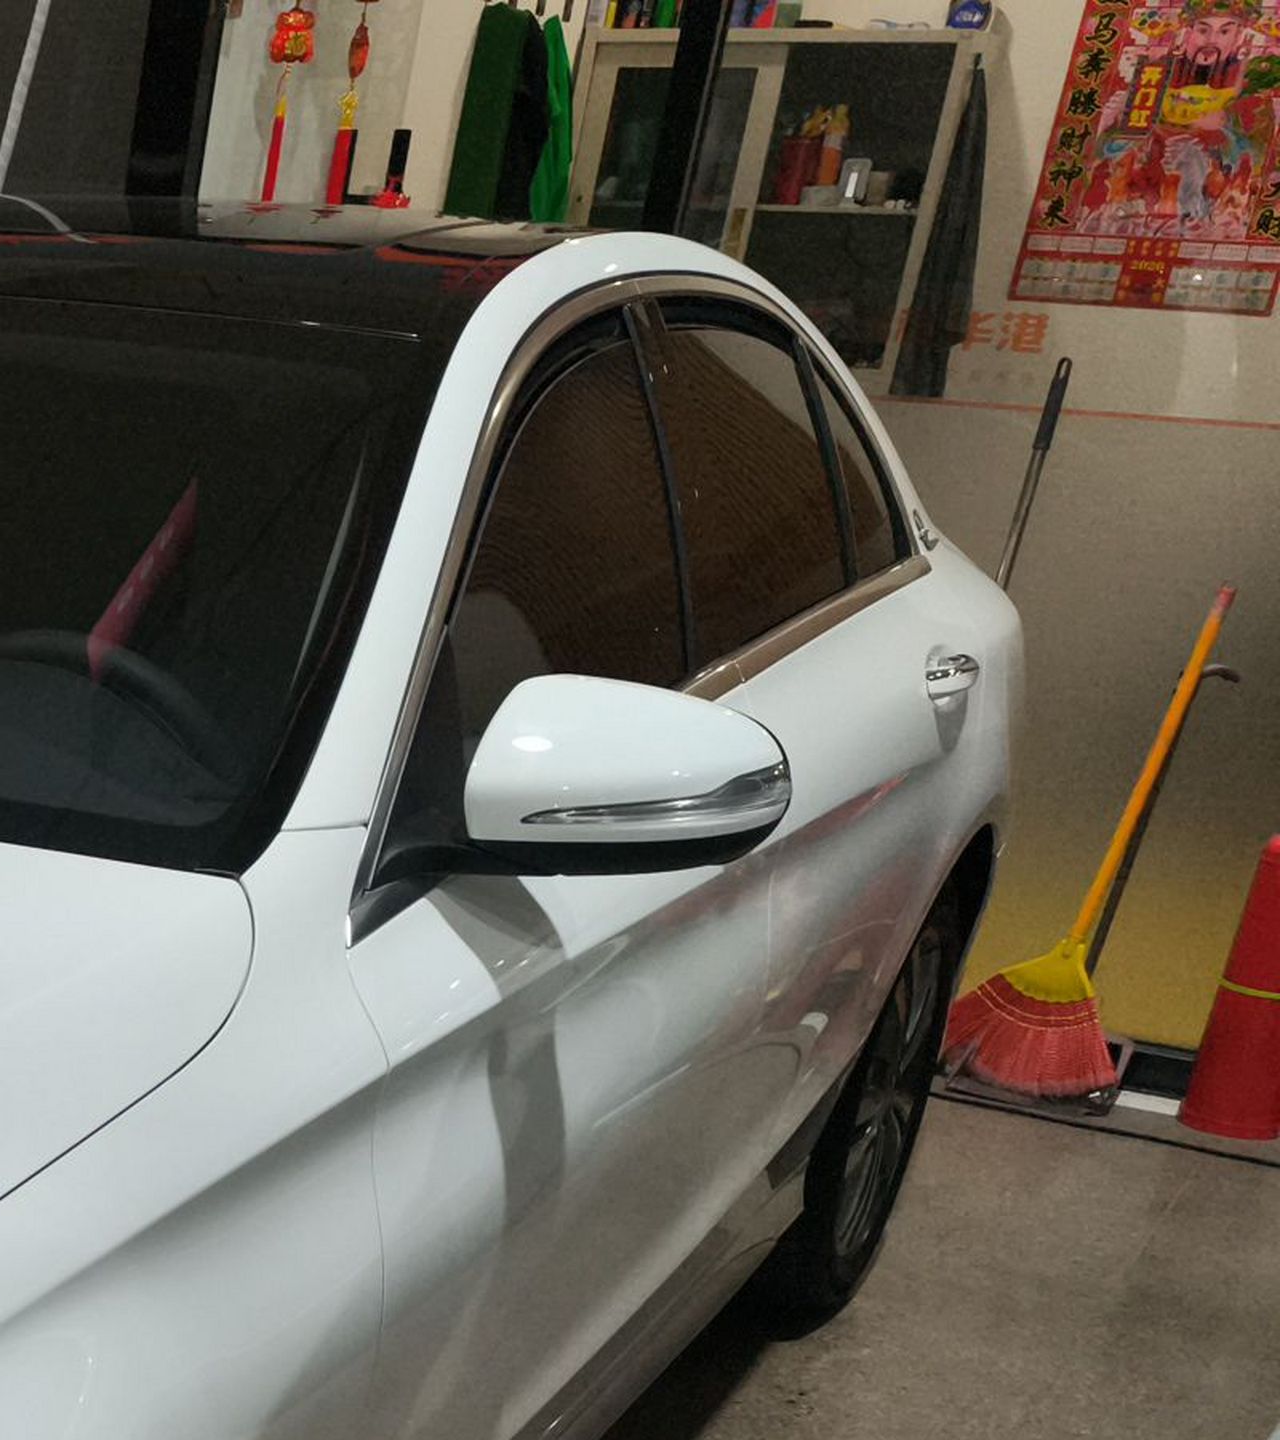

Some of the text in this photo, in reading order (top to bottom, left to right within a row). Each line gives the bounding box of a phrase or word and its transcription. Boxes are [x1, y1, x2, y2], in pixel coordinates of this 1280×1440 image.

[1040, 0, 1131, 228] 马奔腾财神来
